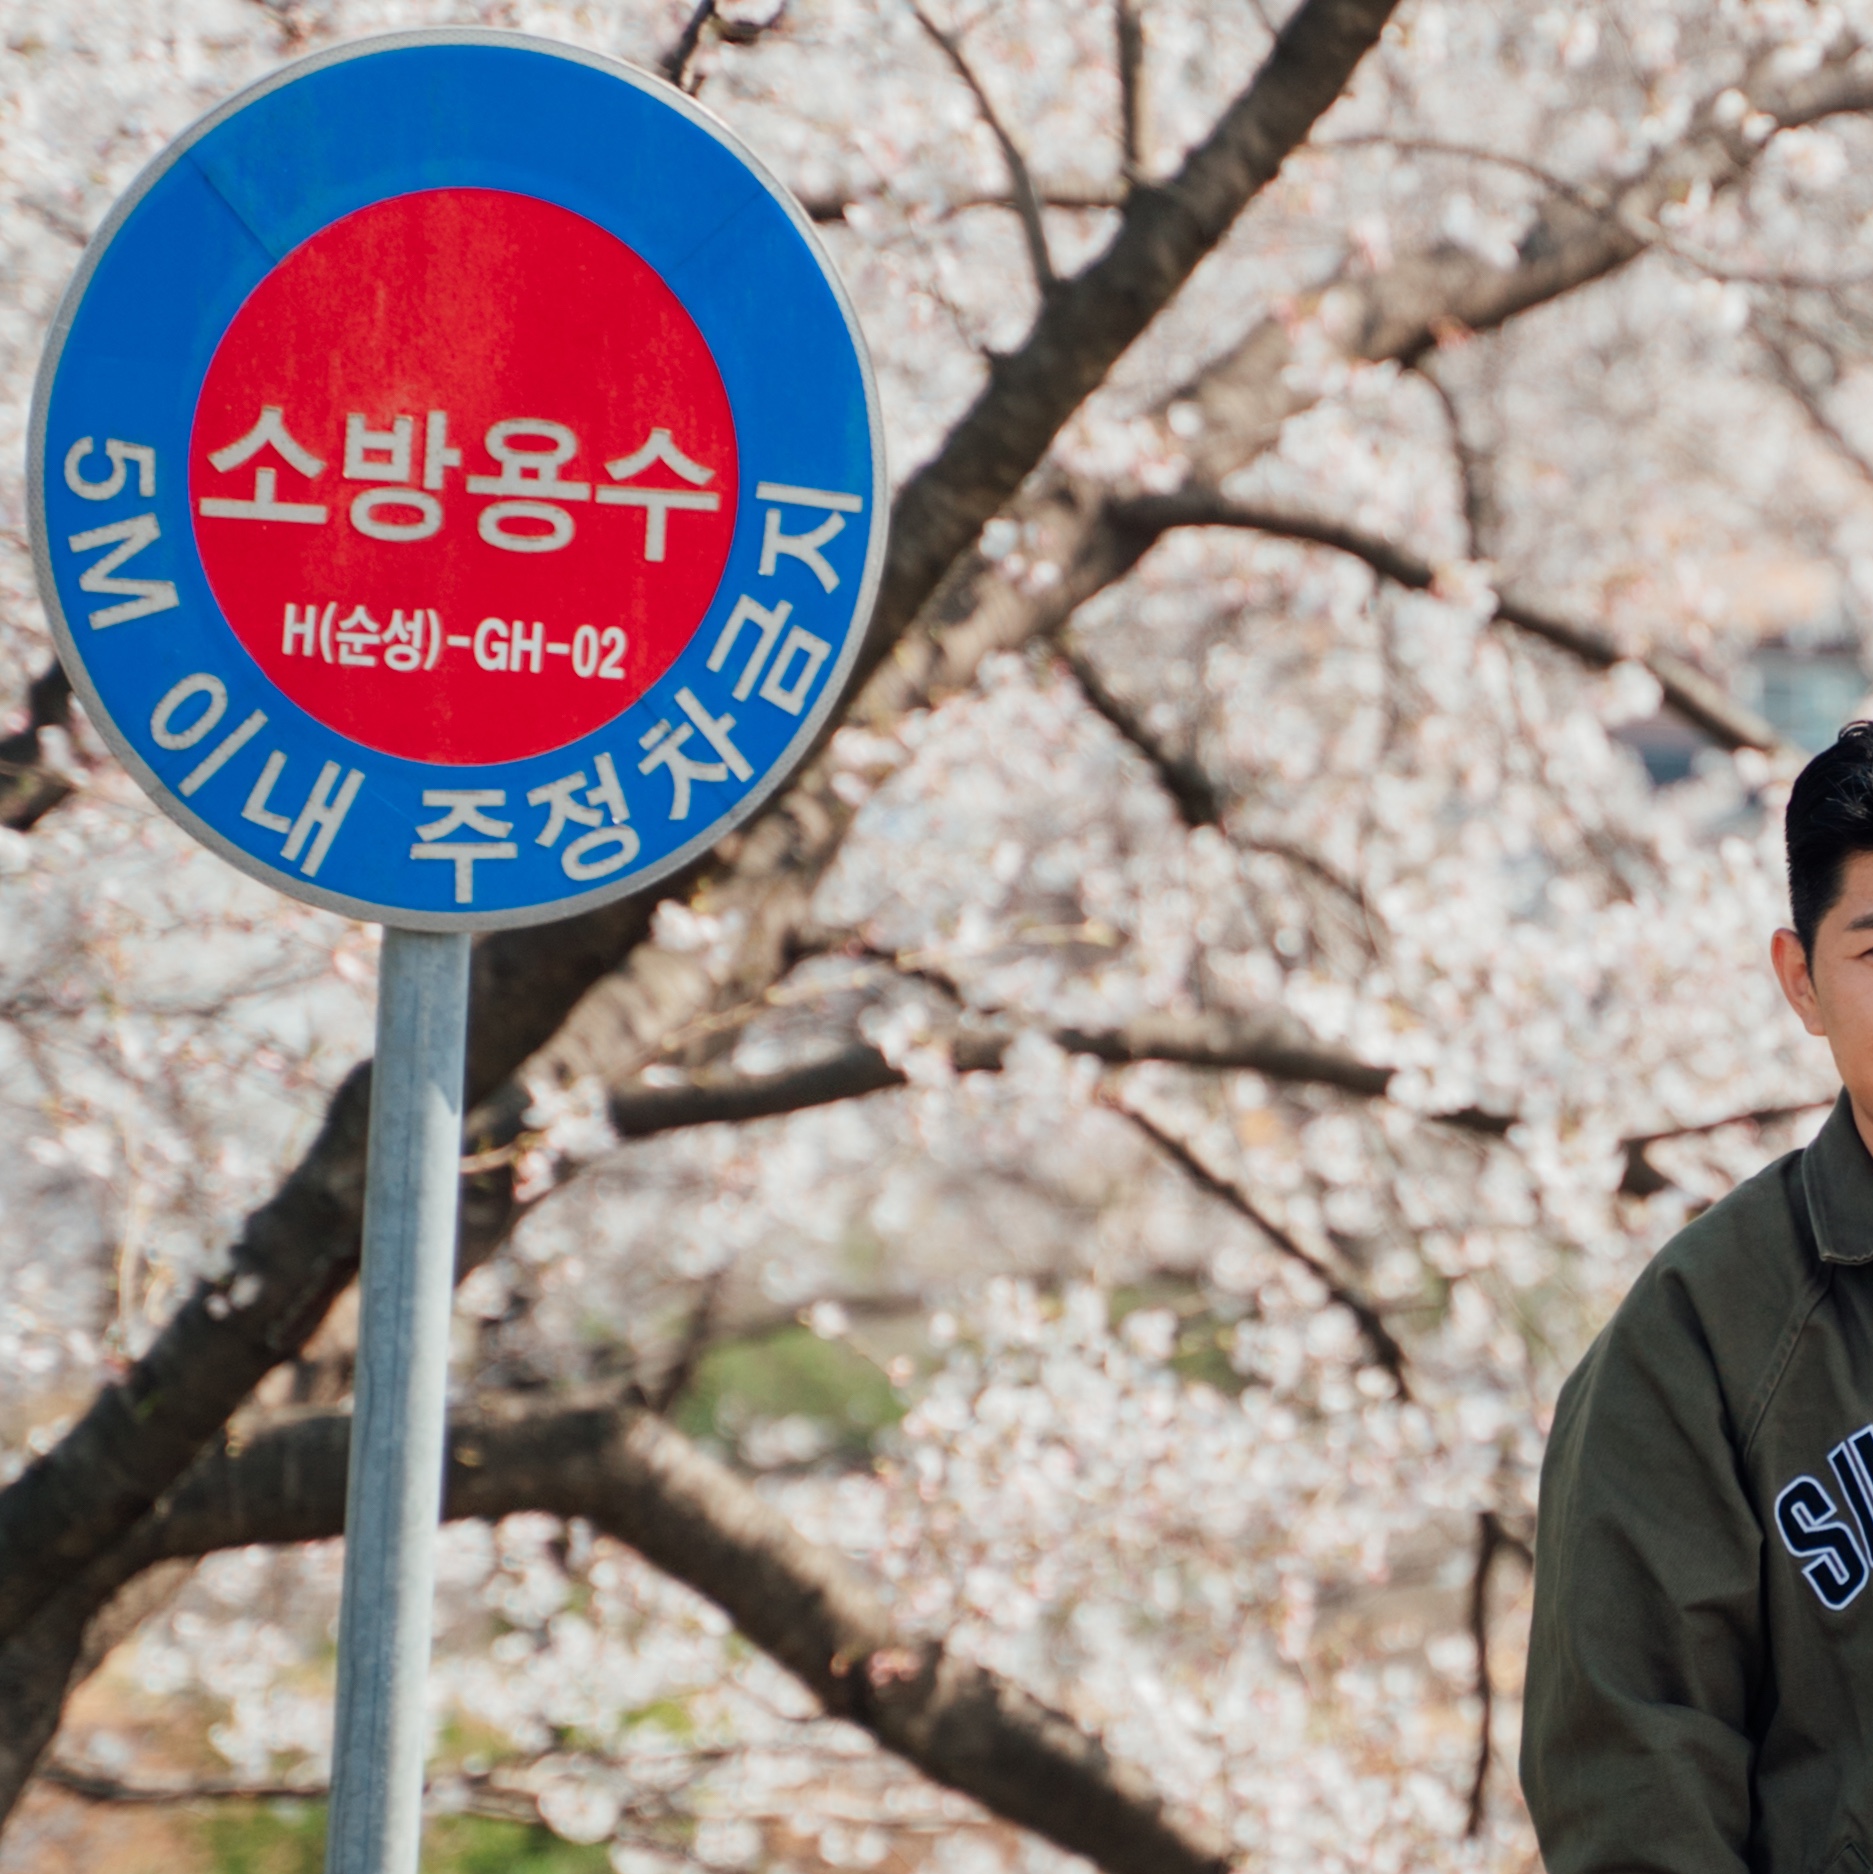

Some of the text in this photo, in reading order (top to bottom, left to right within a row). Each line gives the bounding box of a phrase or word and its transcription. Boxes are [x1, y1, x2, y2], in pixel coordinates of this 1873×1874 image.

[200, 407, 719, 562] 소방용수
[64, 437, 862, 903] 5M 이내 주정차금지
[281, 602, 627, 679] H(순성)-GH-02
